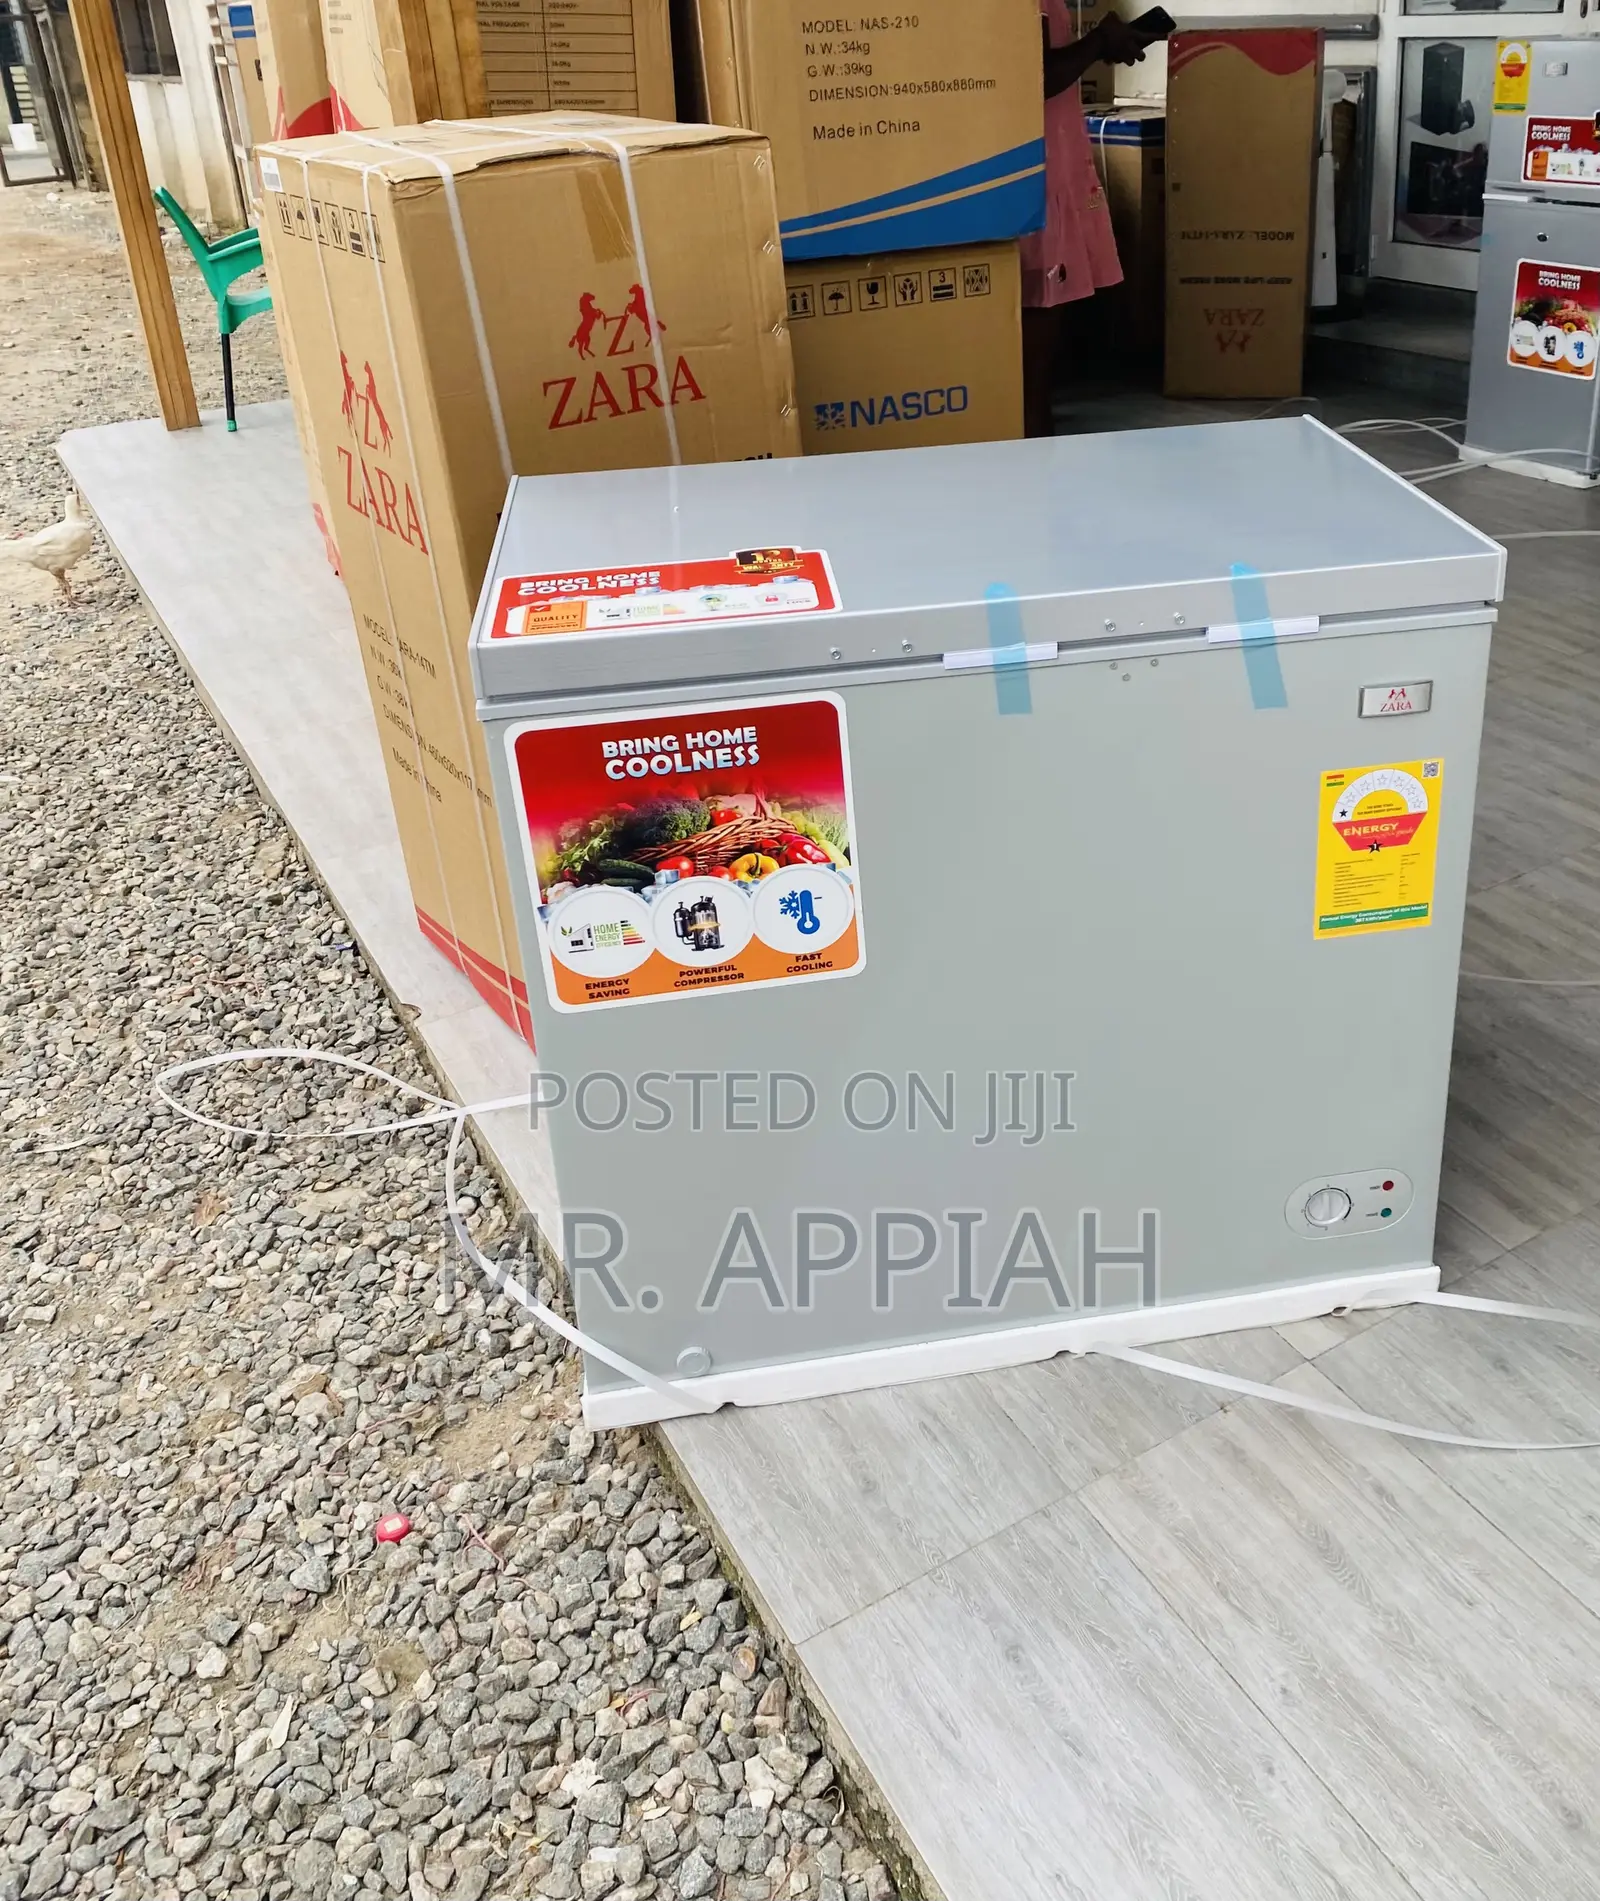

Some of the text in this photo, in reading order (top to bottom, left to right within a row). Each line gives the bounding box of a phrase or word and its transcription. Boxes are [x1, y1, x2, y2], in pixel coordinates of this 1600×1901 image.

[802, 15, 920, 34] MODEL: NAS-210
[812, 119, 921, 141] Made in China
[1531, 131, 1570, 141] COOLNESS
[1538, 278, 1580, 290] COOLNESS
[1203, 308, 1264, 327] ZARA
[543, 355, 706, 430] ZARA
[851, 385, 968, 428] NASCO
[337, 445, 429, 556] ZARA
[517, 577, 660, 596] COOLNESS
[520, 570, 660, 589] BRING HOME
[533, 614, 578, 622] QUALITY
[1380, 702, 1412, 712] ZARA
[602, 726, 757, 759] BRING HOME
[605, 744, 760, 780] COOLNESS
[1343, 822, 1400, 837] ENERGY
[593, 922, 620, 934] HOME
[595, 932, 621, 942] ENERGY
[795, 952, 823, 963] FAST
[679, 964, 737, 978] POWERFUL
[786, 960, 834, 973] COOLING
[585, 978, 630, 990] ENERGY
[673, 972, 745, 988] COMPRESSOR
[588, 988, 630, 1000] SAVING
